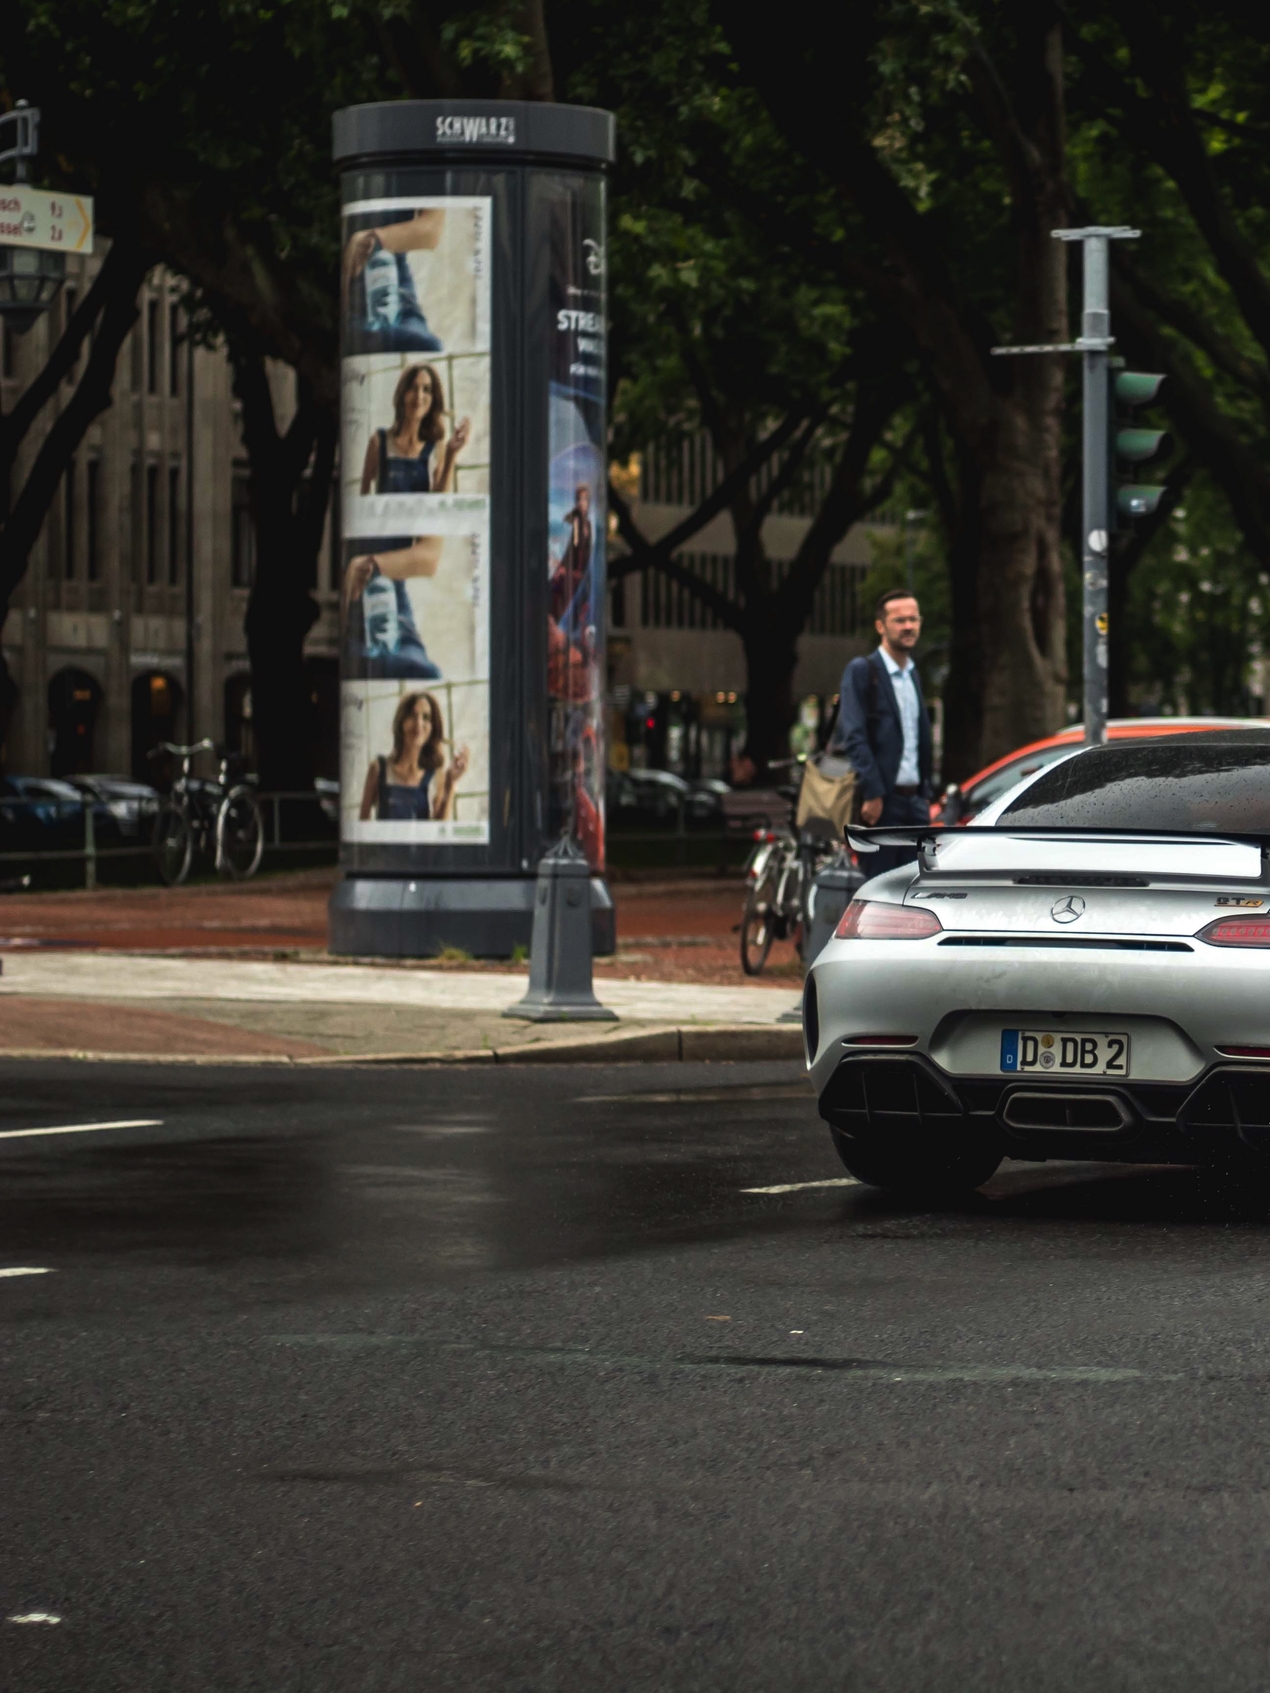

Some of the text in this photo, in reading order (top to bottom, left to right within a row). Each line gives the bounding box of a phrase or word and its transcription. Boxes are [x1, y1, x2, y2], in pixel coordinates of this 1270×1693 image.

[436, 115, 508, 142] SCHWARZ
[1020, 1035, 1124, 1070] D DB 2
